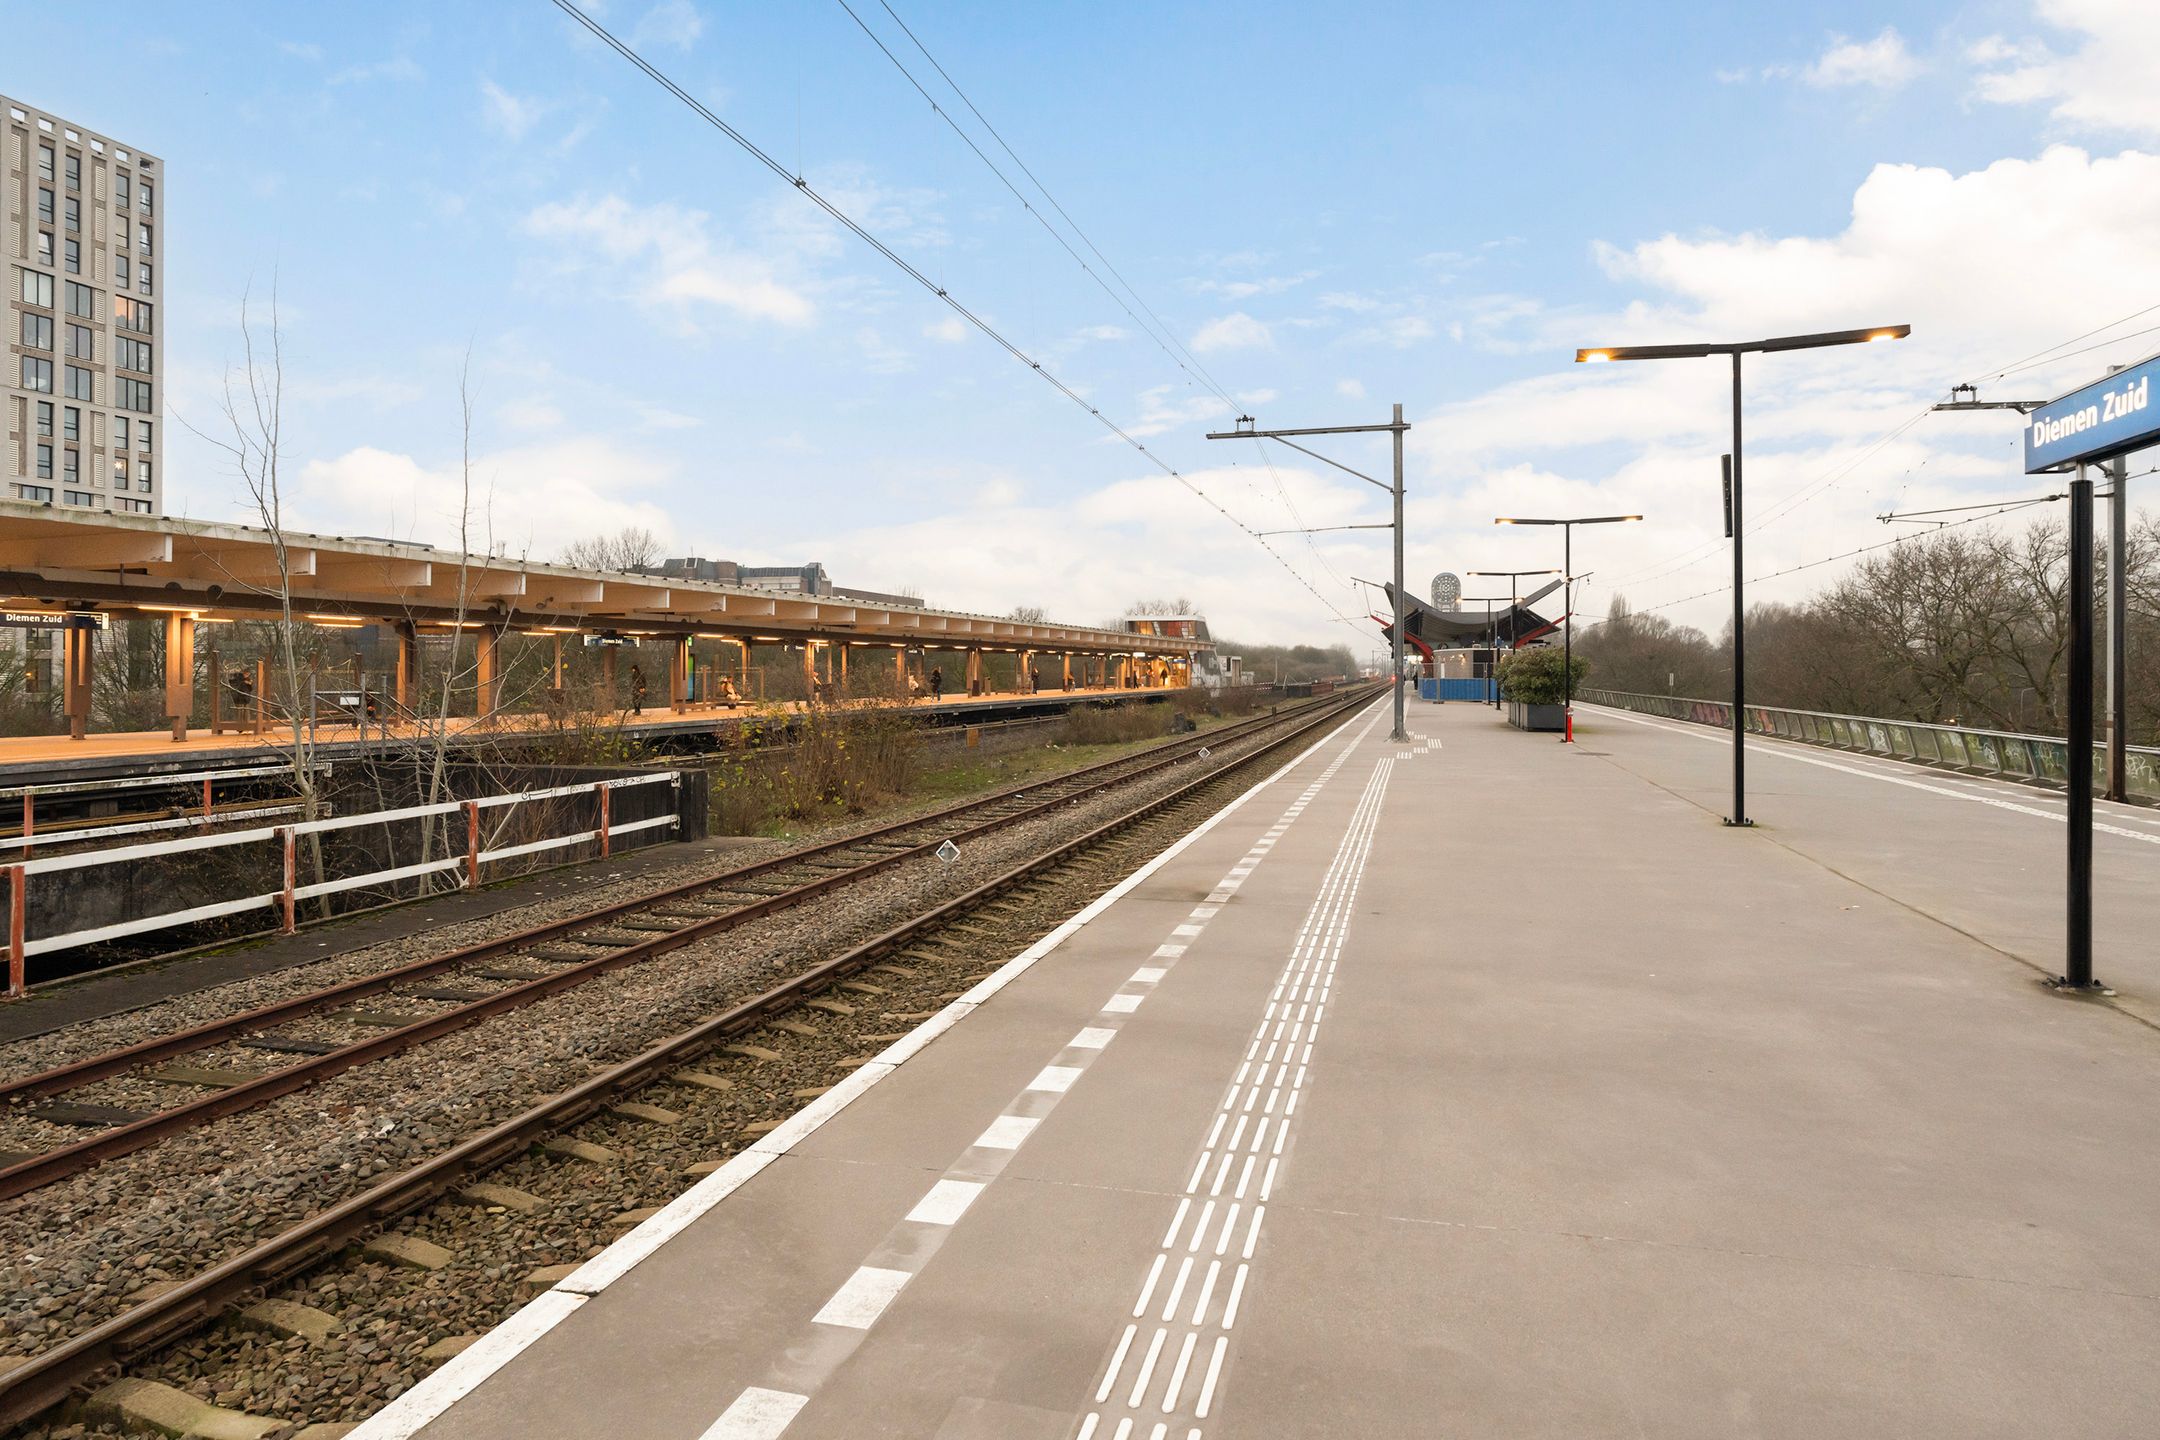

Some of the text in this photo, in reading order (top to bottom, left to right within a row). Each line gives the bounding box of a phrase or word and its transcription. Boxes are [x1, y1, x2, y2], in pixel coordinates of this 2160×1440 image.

[2033, 376, 2148, 448] Diemen Zuid
[6, 613, 63, 623] Diemen Zuid
